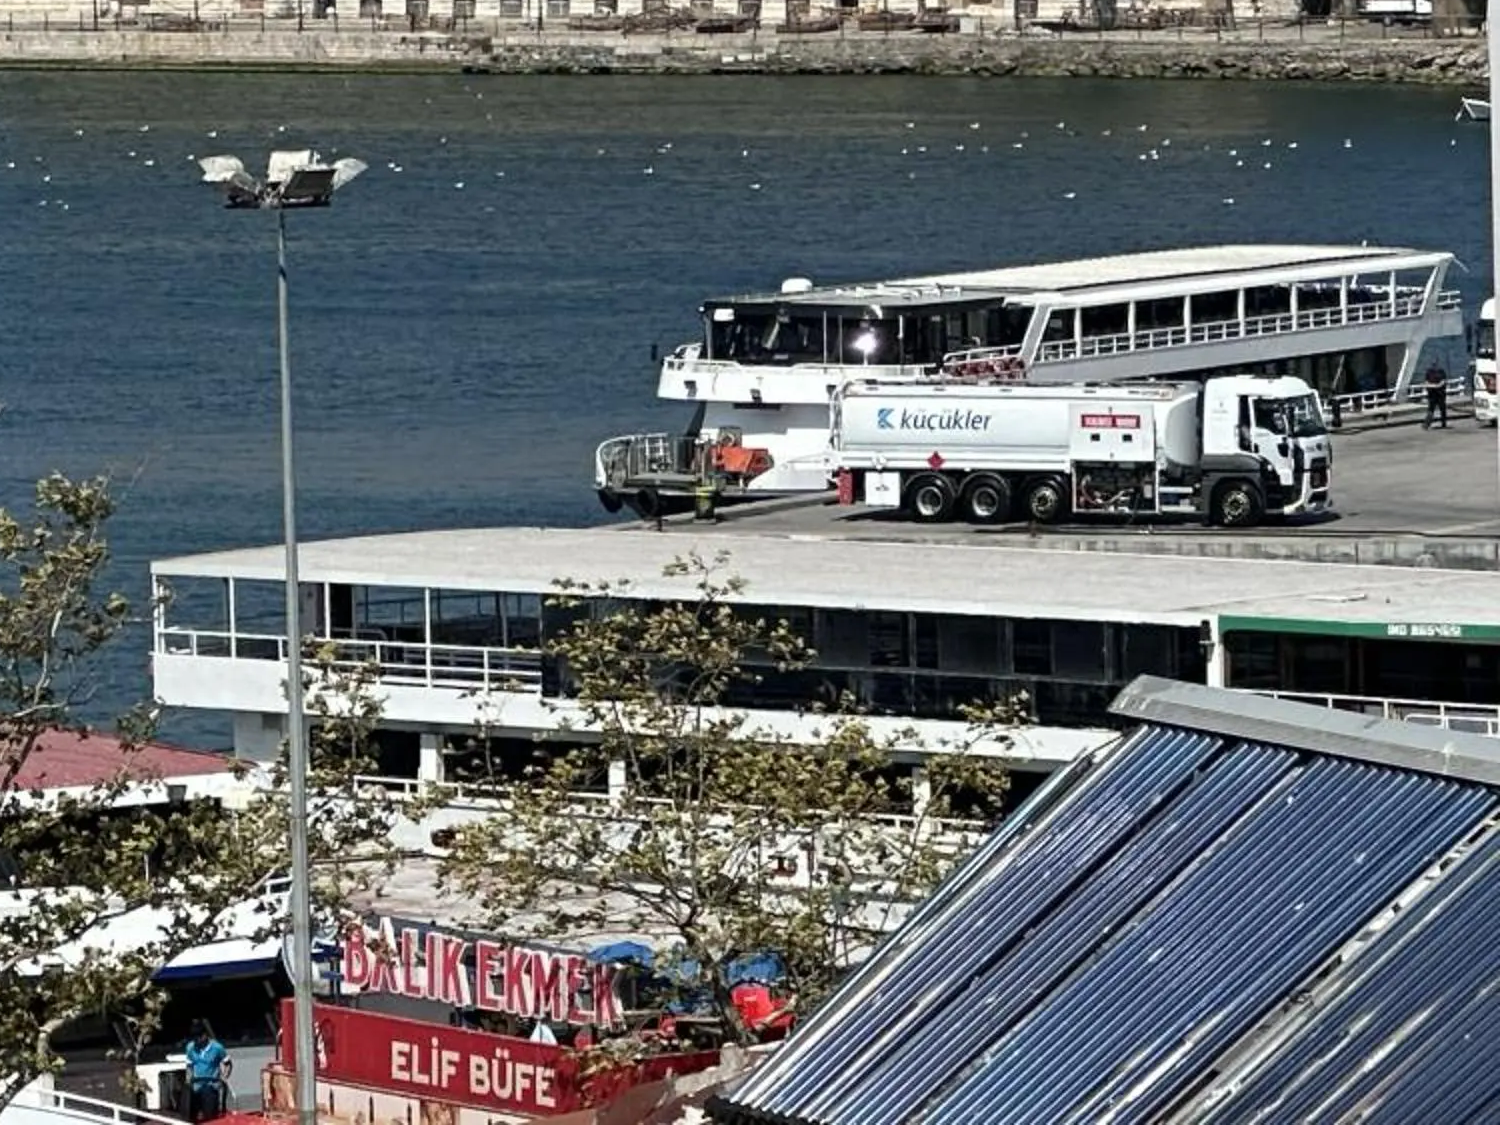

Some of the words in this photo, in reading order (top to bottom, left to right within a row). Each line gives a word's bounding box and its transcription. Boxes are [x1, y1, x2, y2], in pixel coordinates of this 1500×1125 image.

[900, 408, 992, 433] küçükler
[342, 916, 470, 1006] BALIK
[474, 940, 624, 1031] EKMEK
[390, 1036, 461, 1089] ELİF
[468, 1047, 557, 1109] BÜFE
